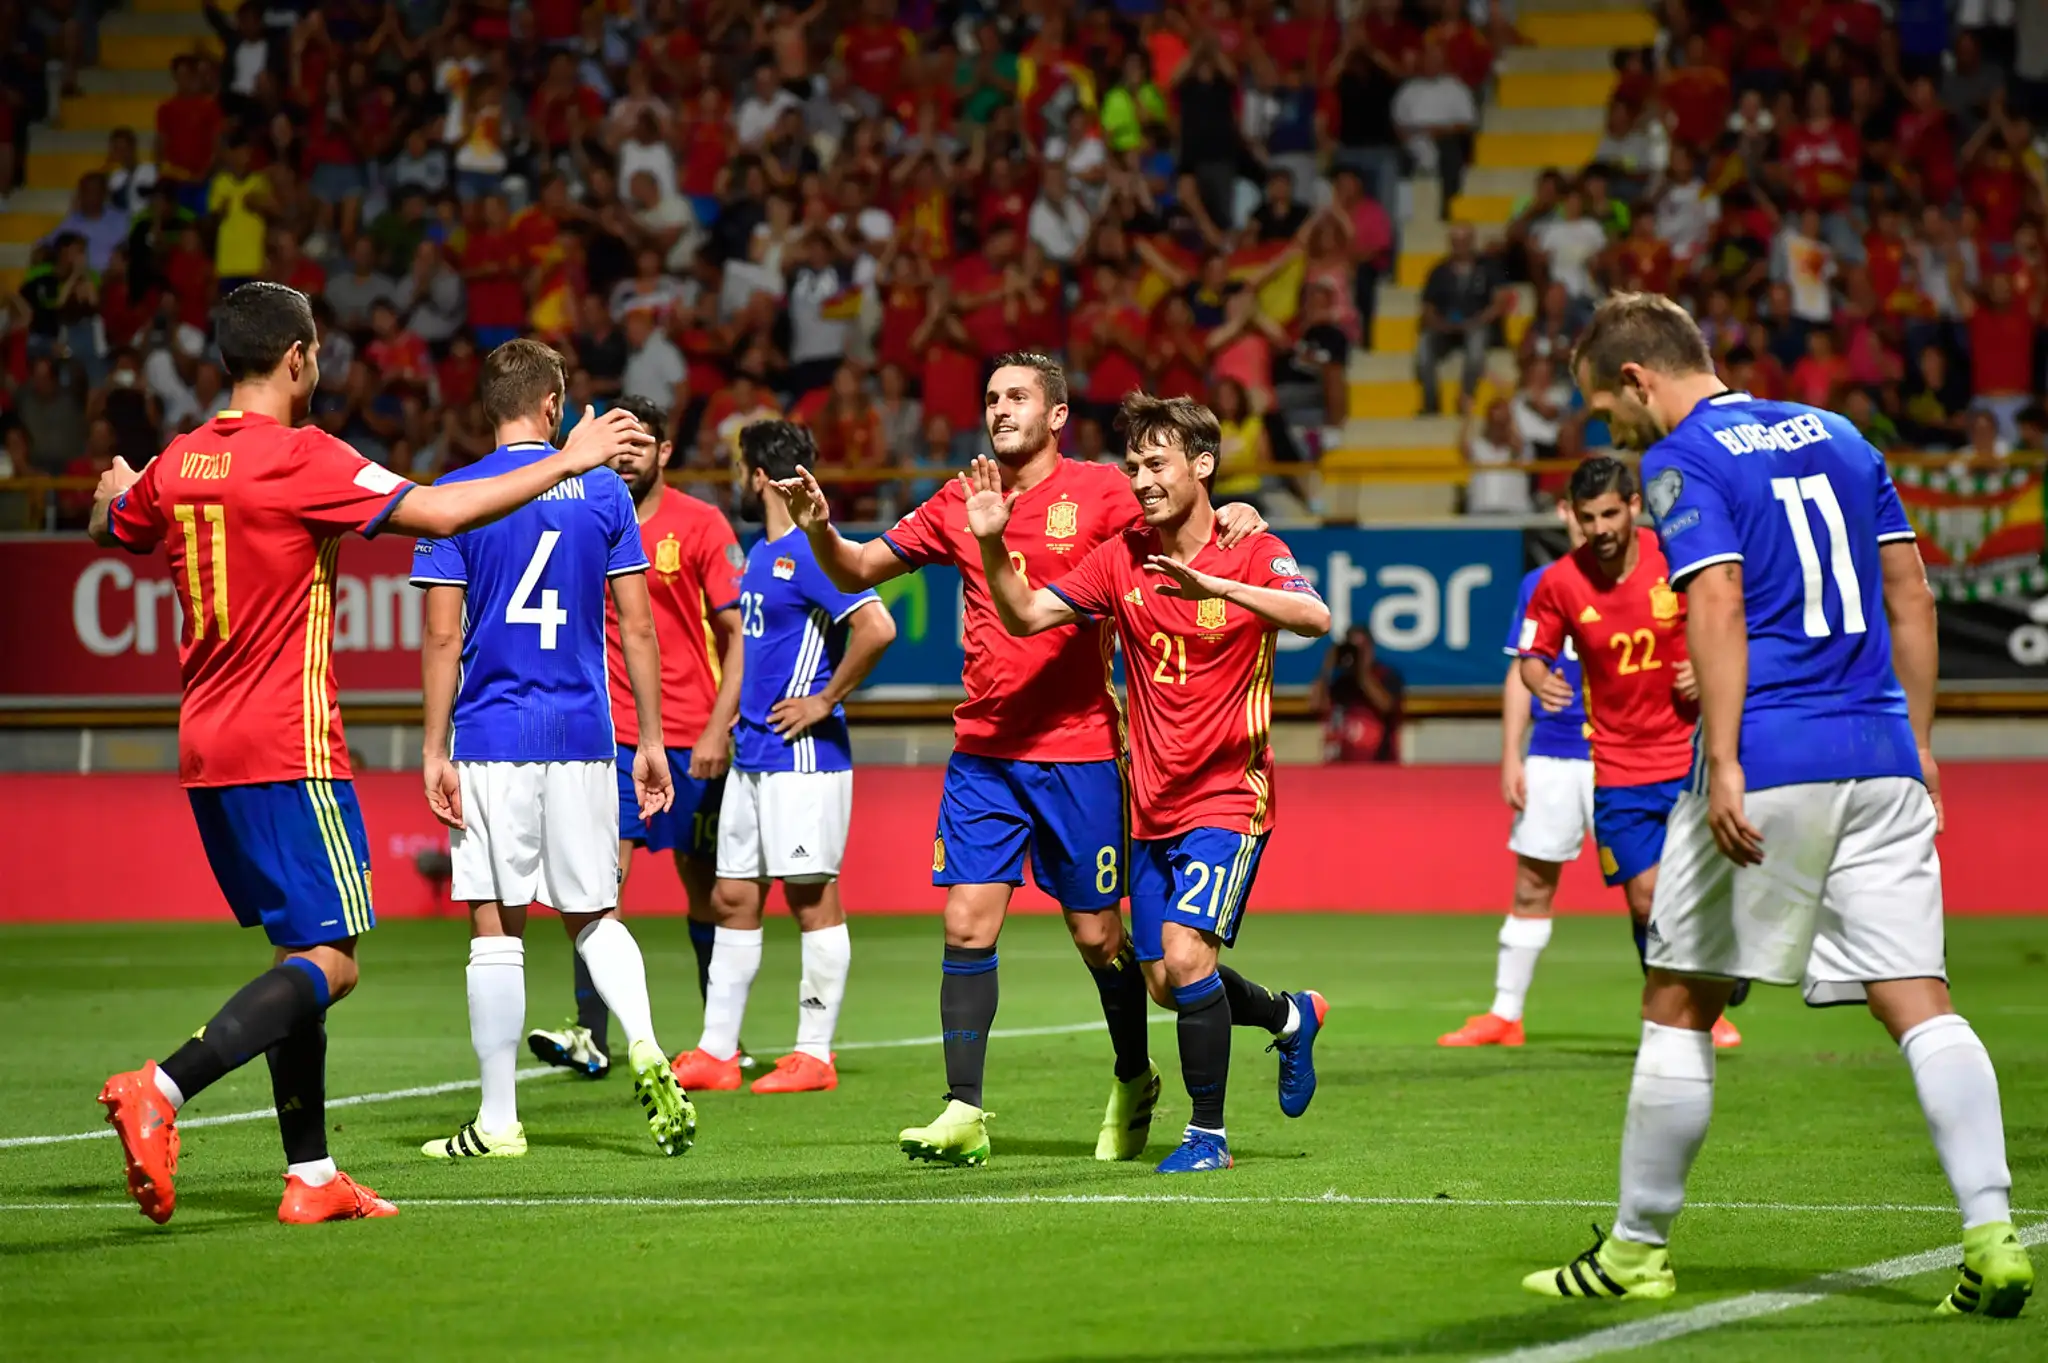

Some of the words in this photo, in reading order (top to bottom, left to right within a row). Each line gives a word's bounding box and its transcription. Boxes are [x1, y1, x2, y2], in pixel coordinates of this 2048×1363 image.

[180, 451, 232, 480] VITOLO
[173, 503, 231, 641] 11
[1770, 472, 1867, 638] 11
[505, 530, 568, 650] 4
[740, 590, 765, 639] 23
[1150, 632, 1188, 685] 21
[1609, 627, 1662, 686] 22
[1095, 845, 1118, 895] 8
[1176, 861, 1227, 918] 21
